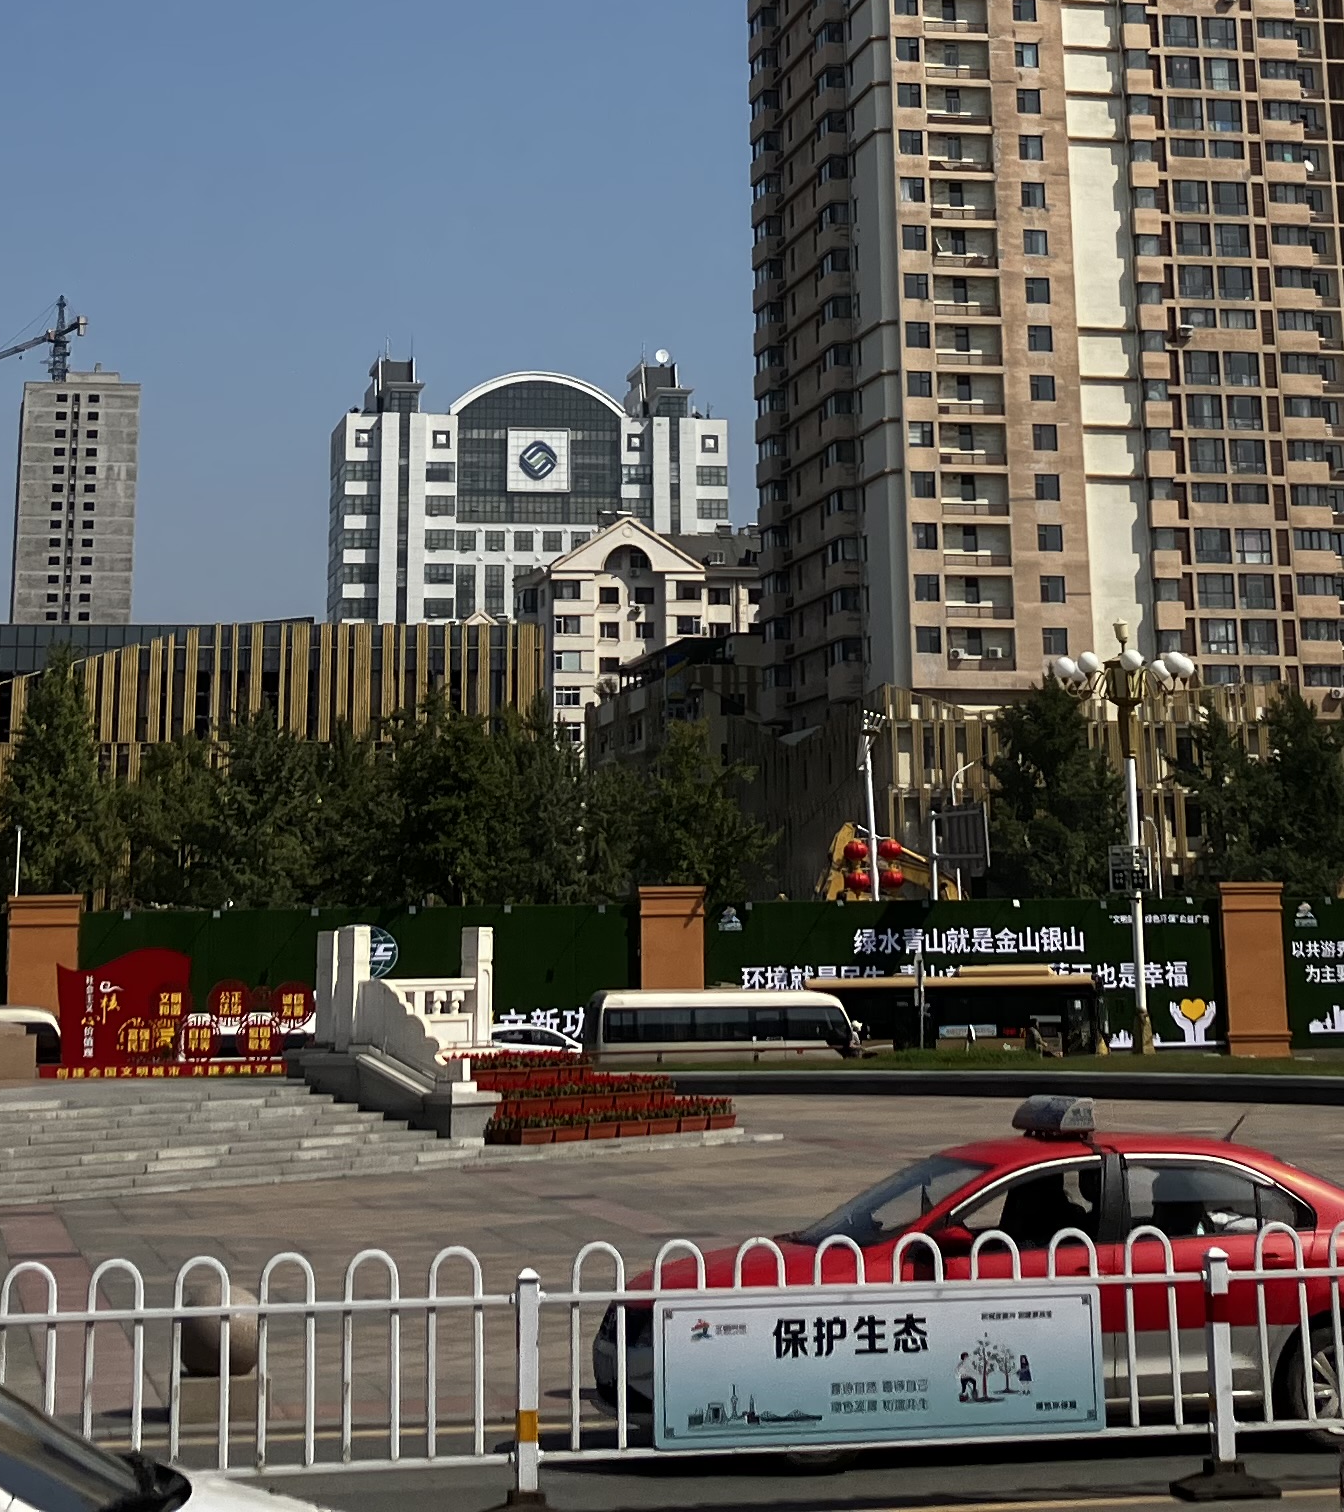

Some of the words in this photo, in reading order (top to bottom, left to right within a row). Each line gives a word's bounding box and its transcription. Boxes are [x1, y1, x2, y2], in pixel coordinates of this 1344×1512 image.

[853, 926, 1086, 955] 绿水青山就是金山银山
[56, 1066, 181, 1080] 创建全国文明城市
[772, 1313, 929, 1360] 保护生态
